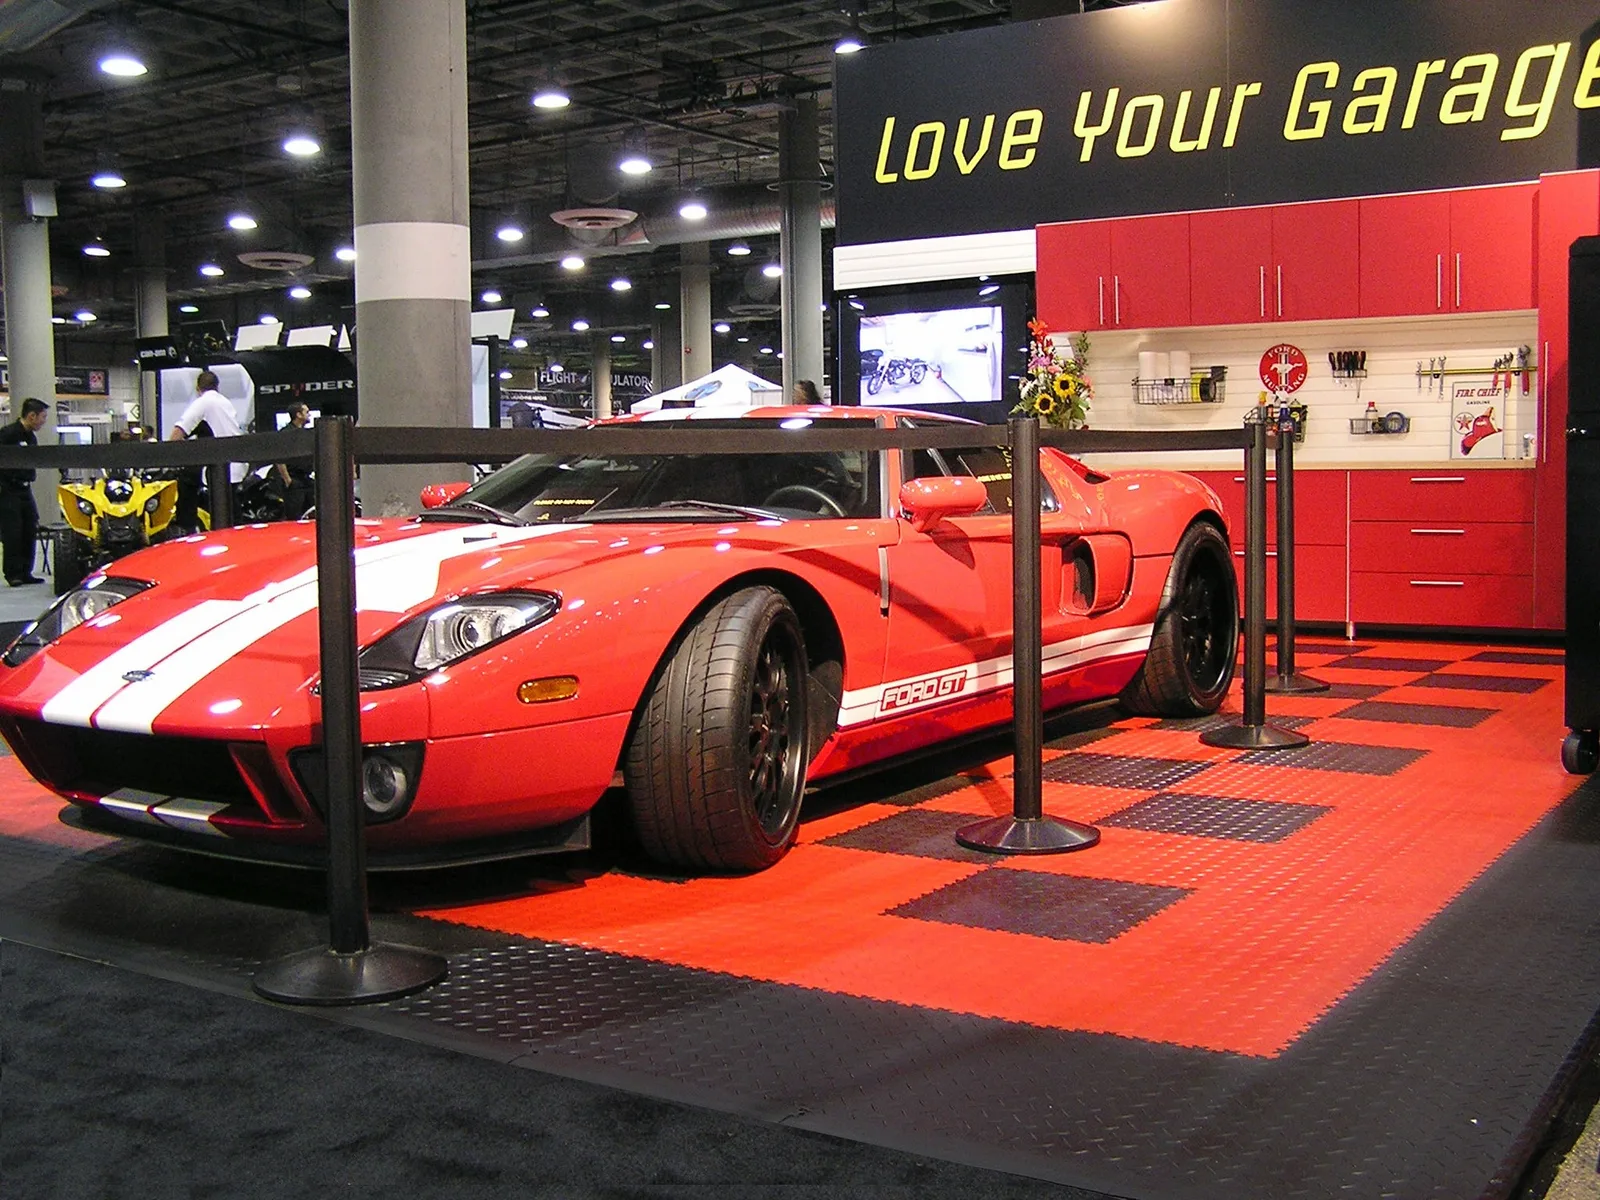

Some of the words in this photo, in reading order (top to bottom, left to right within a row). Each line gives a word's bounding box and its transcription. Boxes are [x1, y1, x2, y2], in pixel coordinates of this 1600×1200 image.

[875, 108, 1044, 184] Love
[1073, 82, 1262, 163] Your
[1267, 346, 1299, 358] FORD
[540, 371, 578, 384] FLIGHT
[1262, 373, 1305, 392] MUSANG
[259, 379, 355, 396] SPYDER
[1455, 388, 1476, 398] FIRE
[1477, 388, 1502, 397] CHIEF
[882, 678, 938, 710] FORD
[938, 671, 967, 695] GT
